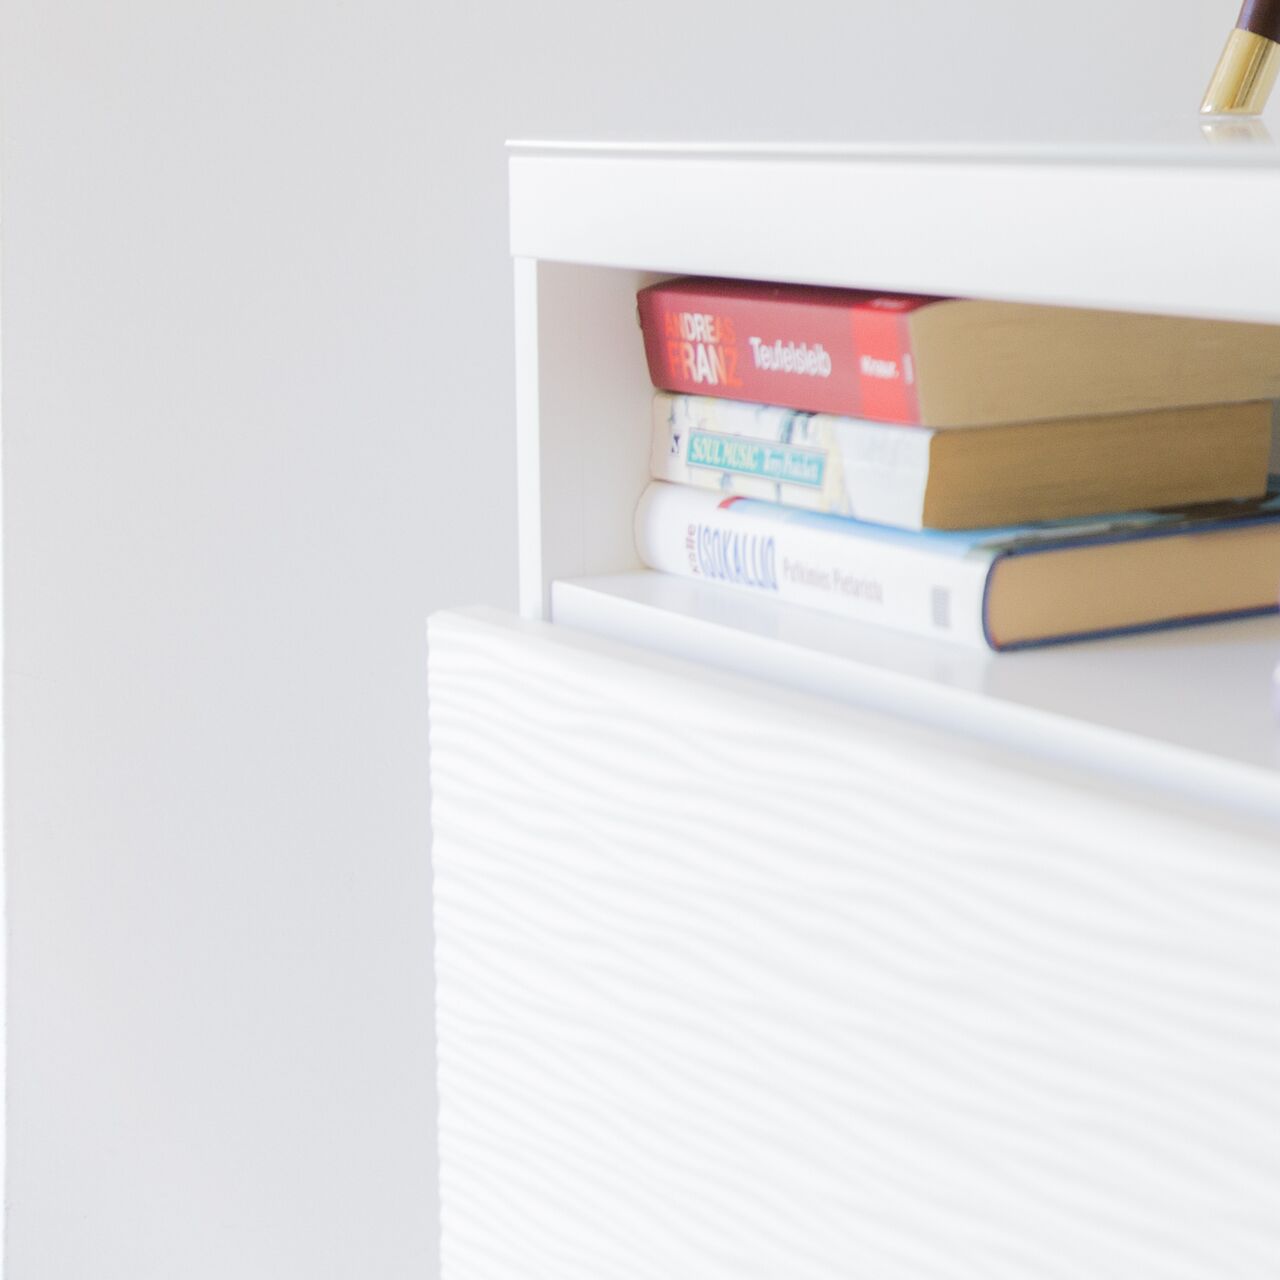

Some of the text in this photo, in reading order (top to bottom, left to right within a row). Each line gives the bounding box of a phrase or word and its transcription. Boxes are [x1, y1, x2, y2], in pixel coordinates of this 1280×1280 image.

[666, 341, 745, 388] FRANZ
[749, 335, 833, 379] Teufelsleib
[690, 436, 721, 464] SOUL
[721, 441, 760, 472] MUSIC
